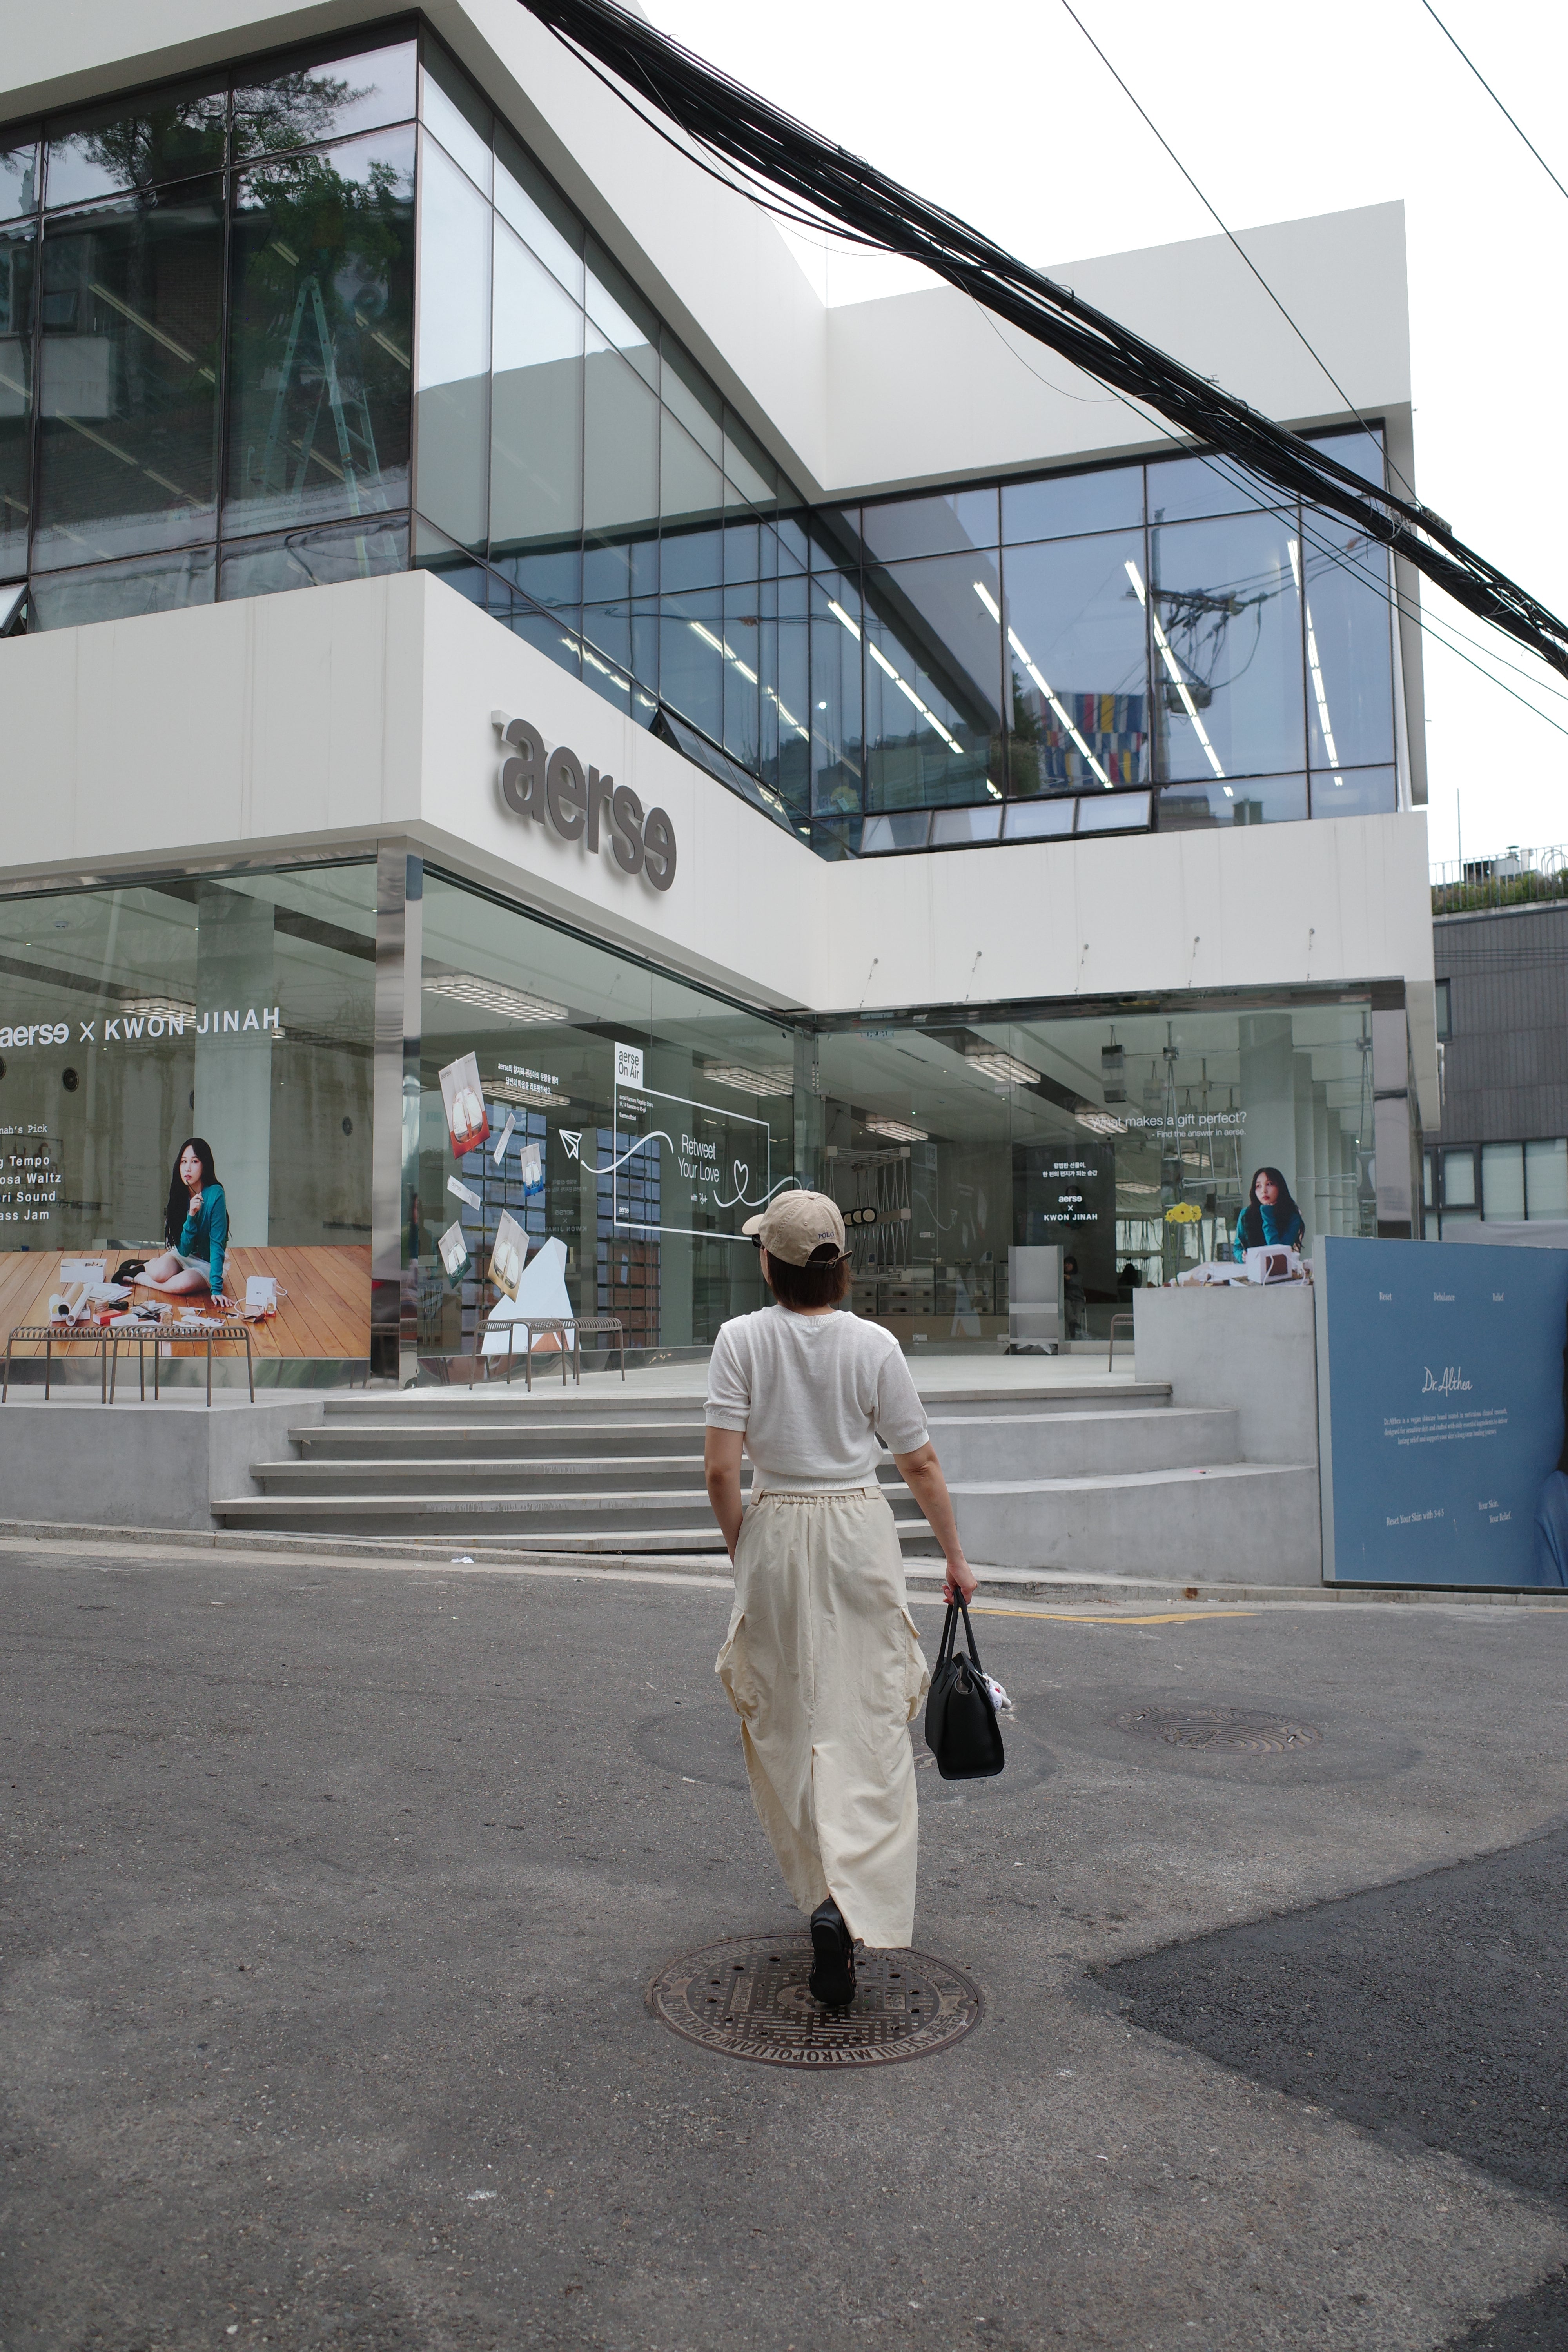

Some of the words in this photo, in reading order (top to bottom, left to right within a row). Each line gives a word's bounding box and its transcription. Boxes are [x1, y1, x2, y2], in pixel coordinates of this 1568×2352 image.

[498, 718, 677, 891] aerse
[0, 1023, 69, 1048] aerse
[105, 1014, 183, 1040] KWON
[197, 1007, 279, 1034] JINAH
[619, 1050, 639, 1066] aerse
[498, 1063, 513, 1073] aerse의
[513, 1065, 524, 1076] 향기와
[525, 1068, 540, 1080] 권진아의
[540, 1073, 551, 1083] 문장을
[552, 1075, 559, 1085] 빌려
[618, 1061, 628, 1076] On
[630, 1065, 640, 1079] Air
[505, 1076, 517, 1087] 당신의
[517, 1080, 529, 1090] 마음을
[530, 1082, 552, 1095] 리트윗하세요.
[1125, 1115, 1163, 1127] makes
[1167, 1117, 1174, 1125] a
[1177, 1113, 1195, 1127] gift
[1199, 1111, 1247, 1127] perfect?
[27, 1123, 48, 1133] Pick
[682, 1134, 716, 1160] Retweet
[10, 1156, 50, 1167] Tempo
[678, 1156, 698, 1179] Your
[700, 1160, 719, 1183] Love
[27, 1172, 62, 1183] Waltz
[16, 1190, 56, 1202] Sound
[24, 1209, 49, 1220] Jam
[1379, 1291, 1392, 1301] Reset
[1434, 1292, 1455, 1301] Rebalance
[1478, 1502, 1488, 1510] Your
[1387, 1517, 1399, 1526] Reset
[1400, 1514, 1411, 1524] Your
[1412, 1512, 1422, 1522] Skin
[1423, 1510, 1433, 1520] with
[1489, 1515, 1499, 1523] Your
[660, 1993, 734, 2050] GOVERNMENT
[730, 2040, 873, 2062] METROPOLITAN
[871, 2036, 930, 2059] SEOUL
